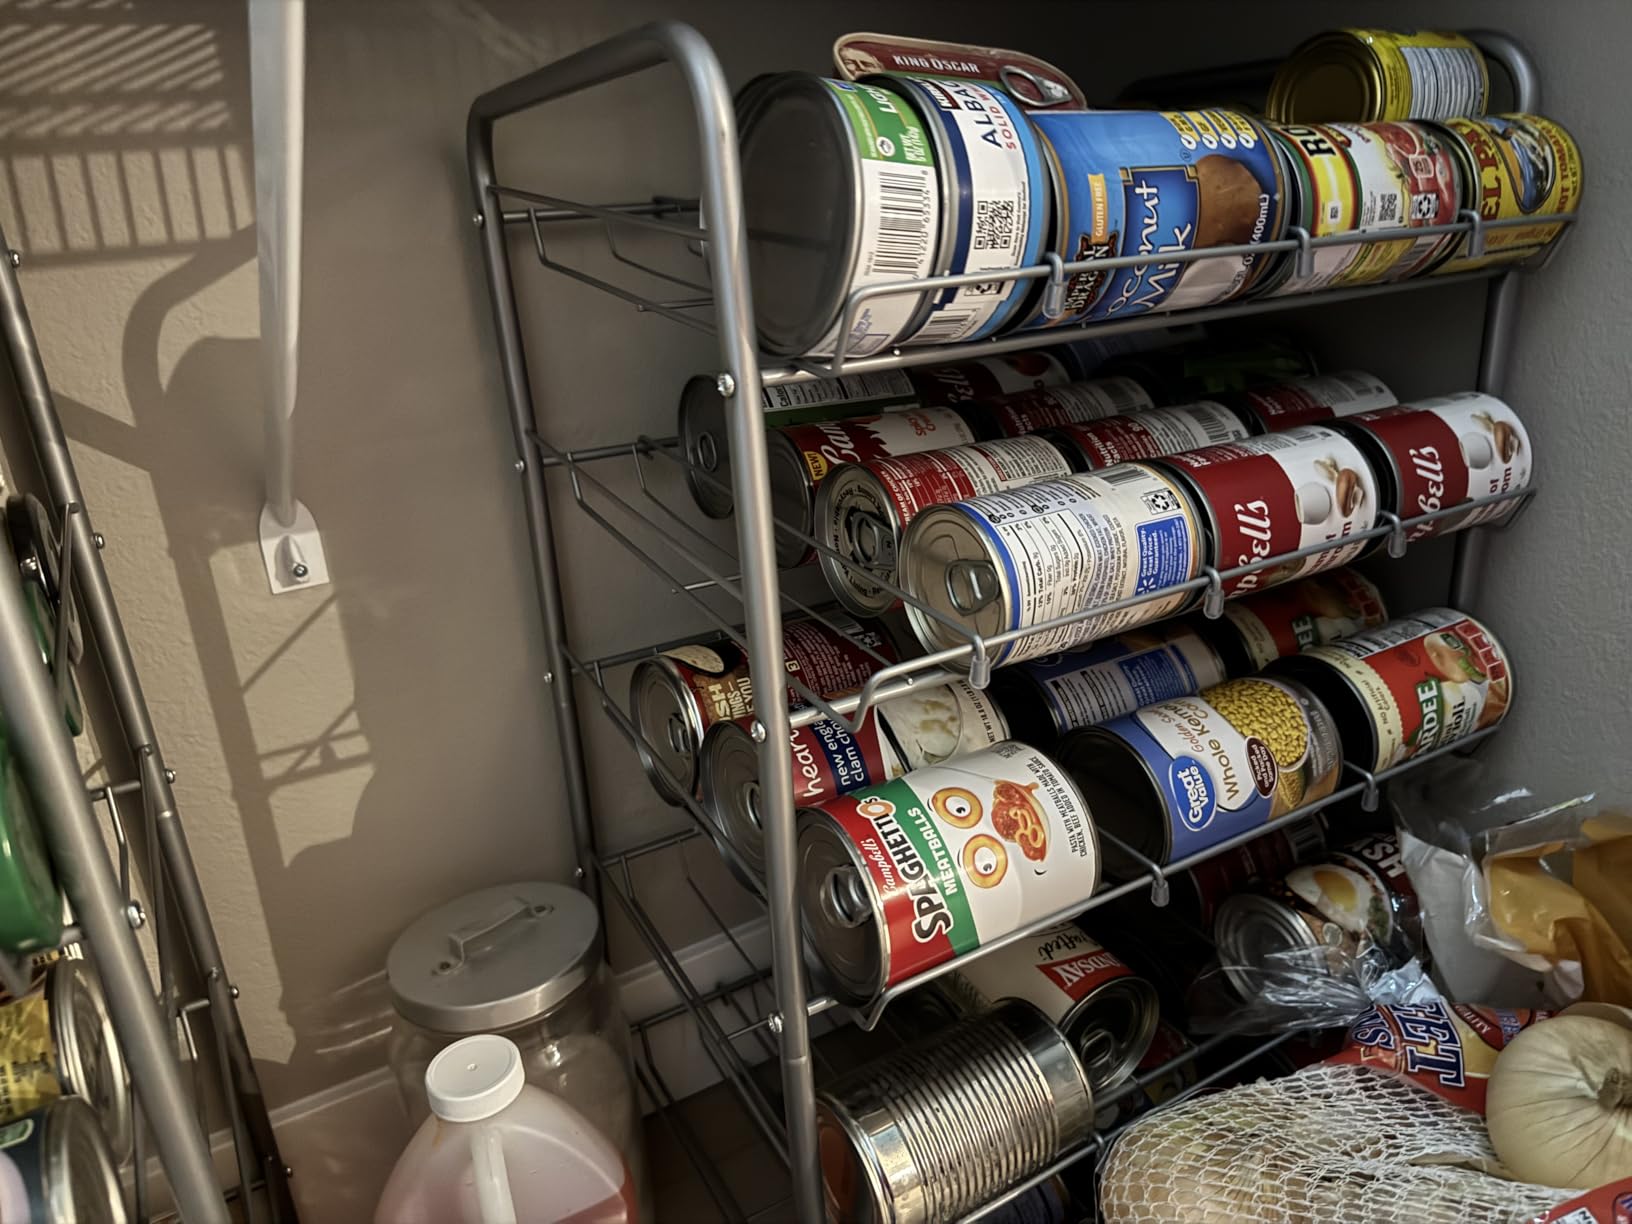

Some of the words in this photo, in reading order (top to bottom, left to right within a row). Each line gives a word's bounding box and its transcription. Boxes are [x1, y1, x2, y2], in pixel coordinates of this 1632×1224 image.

[893, 54, 930, 69] KING
[932, 57, 981, 74] OSCAR
[990, 105, 1017, 150] SOLID
[1095, 201, 1105, 237] GLUTEN
[1104, 179, 1160, 318] oconut
[1129, 222, 1192, 308] Mik
[1140, 557, 1148, 578] Great
[1174, 721, 1205, 753] Golden
[832, 752, 852, 786] new
[845, 745, 866, 782] clam
[1036, 773, 1051, 788] MADE
[1042, 768, 1061, 788] TOMATO
[1208, 739, 1240, 801] Whole
[1046, 786, 1069, 818] MEATBALLS
[1177, 768, 1204, 824] Great
[1189, 764, 1210, 807] Value
[1060, 794, 1075, 814] ADDED
[1063, 819, 1074, 835] WITH
[1070, 814, 1081, 829] BEEF
[907, 807, 959, 897] MEATBALLS
[1068, 834, 1078, 853] PASTA
[1075, 829, 1088, 858] CHICKEN,
[860, 837, 898, 898] Campbell's
[1051, 950, 1122, 988] INDSAY
